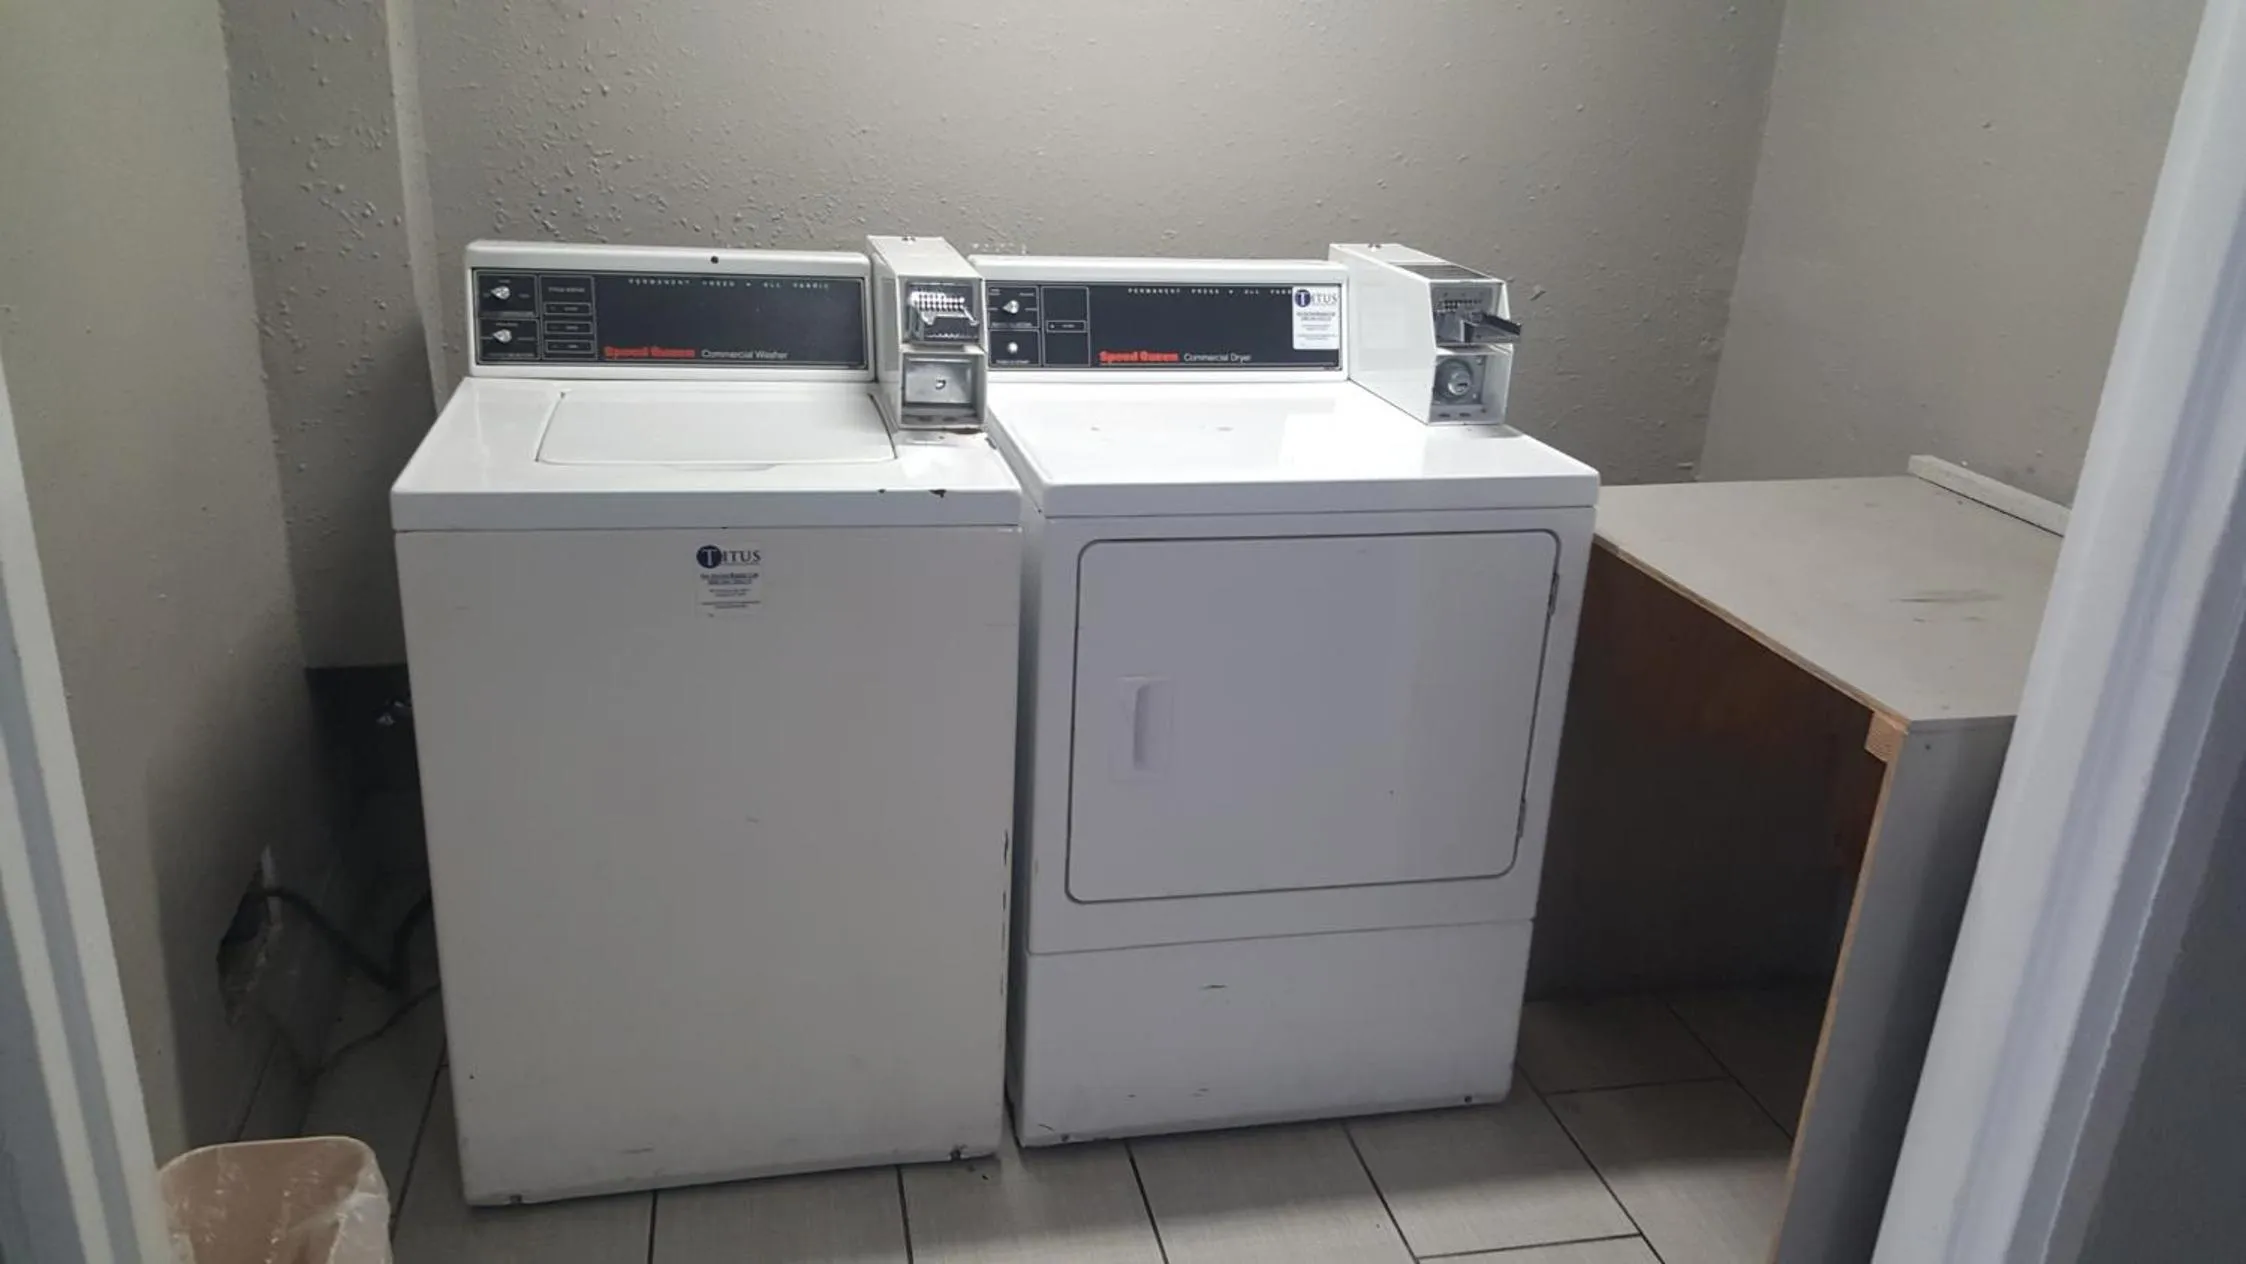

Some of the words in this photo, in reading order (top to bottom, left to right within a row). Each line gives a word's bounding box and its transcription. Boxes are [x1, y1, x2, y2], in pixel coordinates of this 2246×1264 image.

[1295, 290, 1338, 307] TITUS
[604, 346, 649, 360] Speed
[701, 348, 754, 359] Commercial
[755, 349, 788, 360] Washer
[1099, 350, 1138, 363] Speed
[1139, 350, 1179, 362] Queen
[1183, 352, 1228, 362] Commercial
[1230, 352, 1251, 364] Dryer
[698, 547, 762, 567] TITUS
